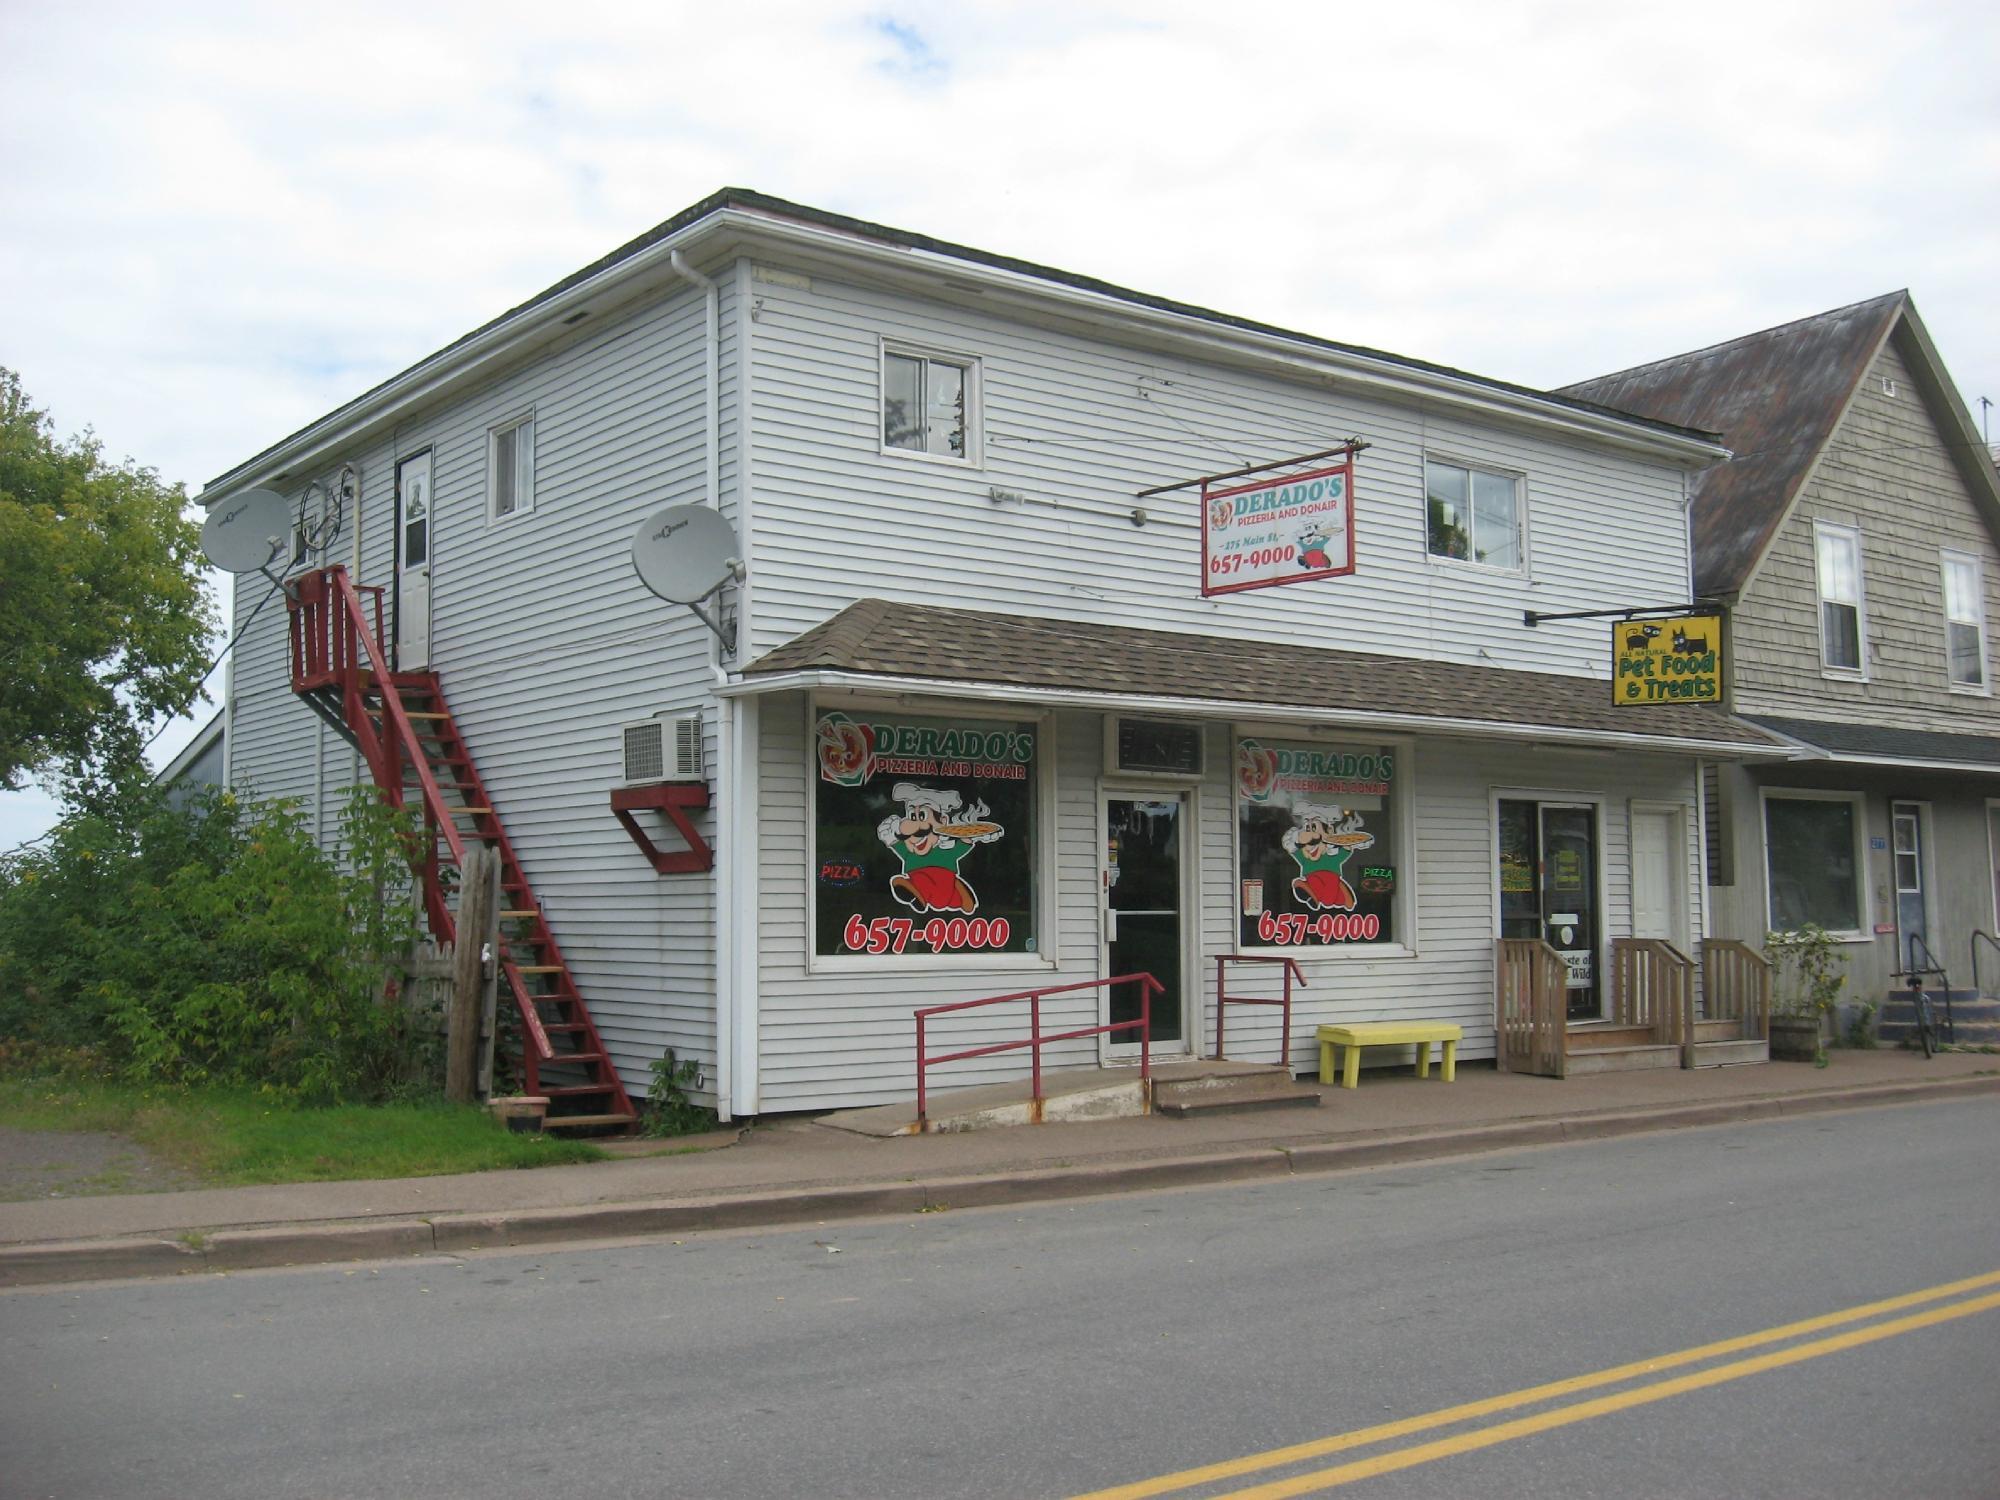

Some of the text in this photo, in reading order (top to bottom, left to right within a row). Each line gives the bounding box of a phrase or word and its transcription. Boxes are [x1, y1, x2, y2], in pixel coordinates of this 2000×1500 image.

[1234, 477, 1342, 515] DERADO'S
[1237, 500, 1337, 527] PIZZERIA AND DONAIR
[1243, 535, 1265, 546] Main
[1210, 545, 1295, 574] 657-9000
[1619, 656, 1654, 678] Pet
[1626, 676, 1715, 698] & Treats
[873, 724, 1034, 763] DERADO'S
[876, 758, 1026, 780] PIZZERIA AND DONAIR
[1276, 749, 1393, 781] DERADO'S
[820, 864, 861, 879] PIZZA
[1363, 867, 1393, 881] PIZZA
[843, 913, 1010, 954] 657-9000
[1258, 910, 1380, 945] 657-9000
